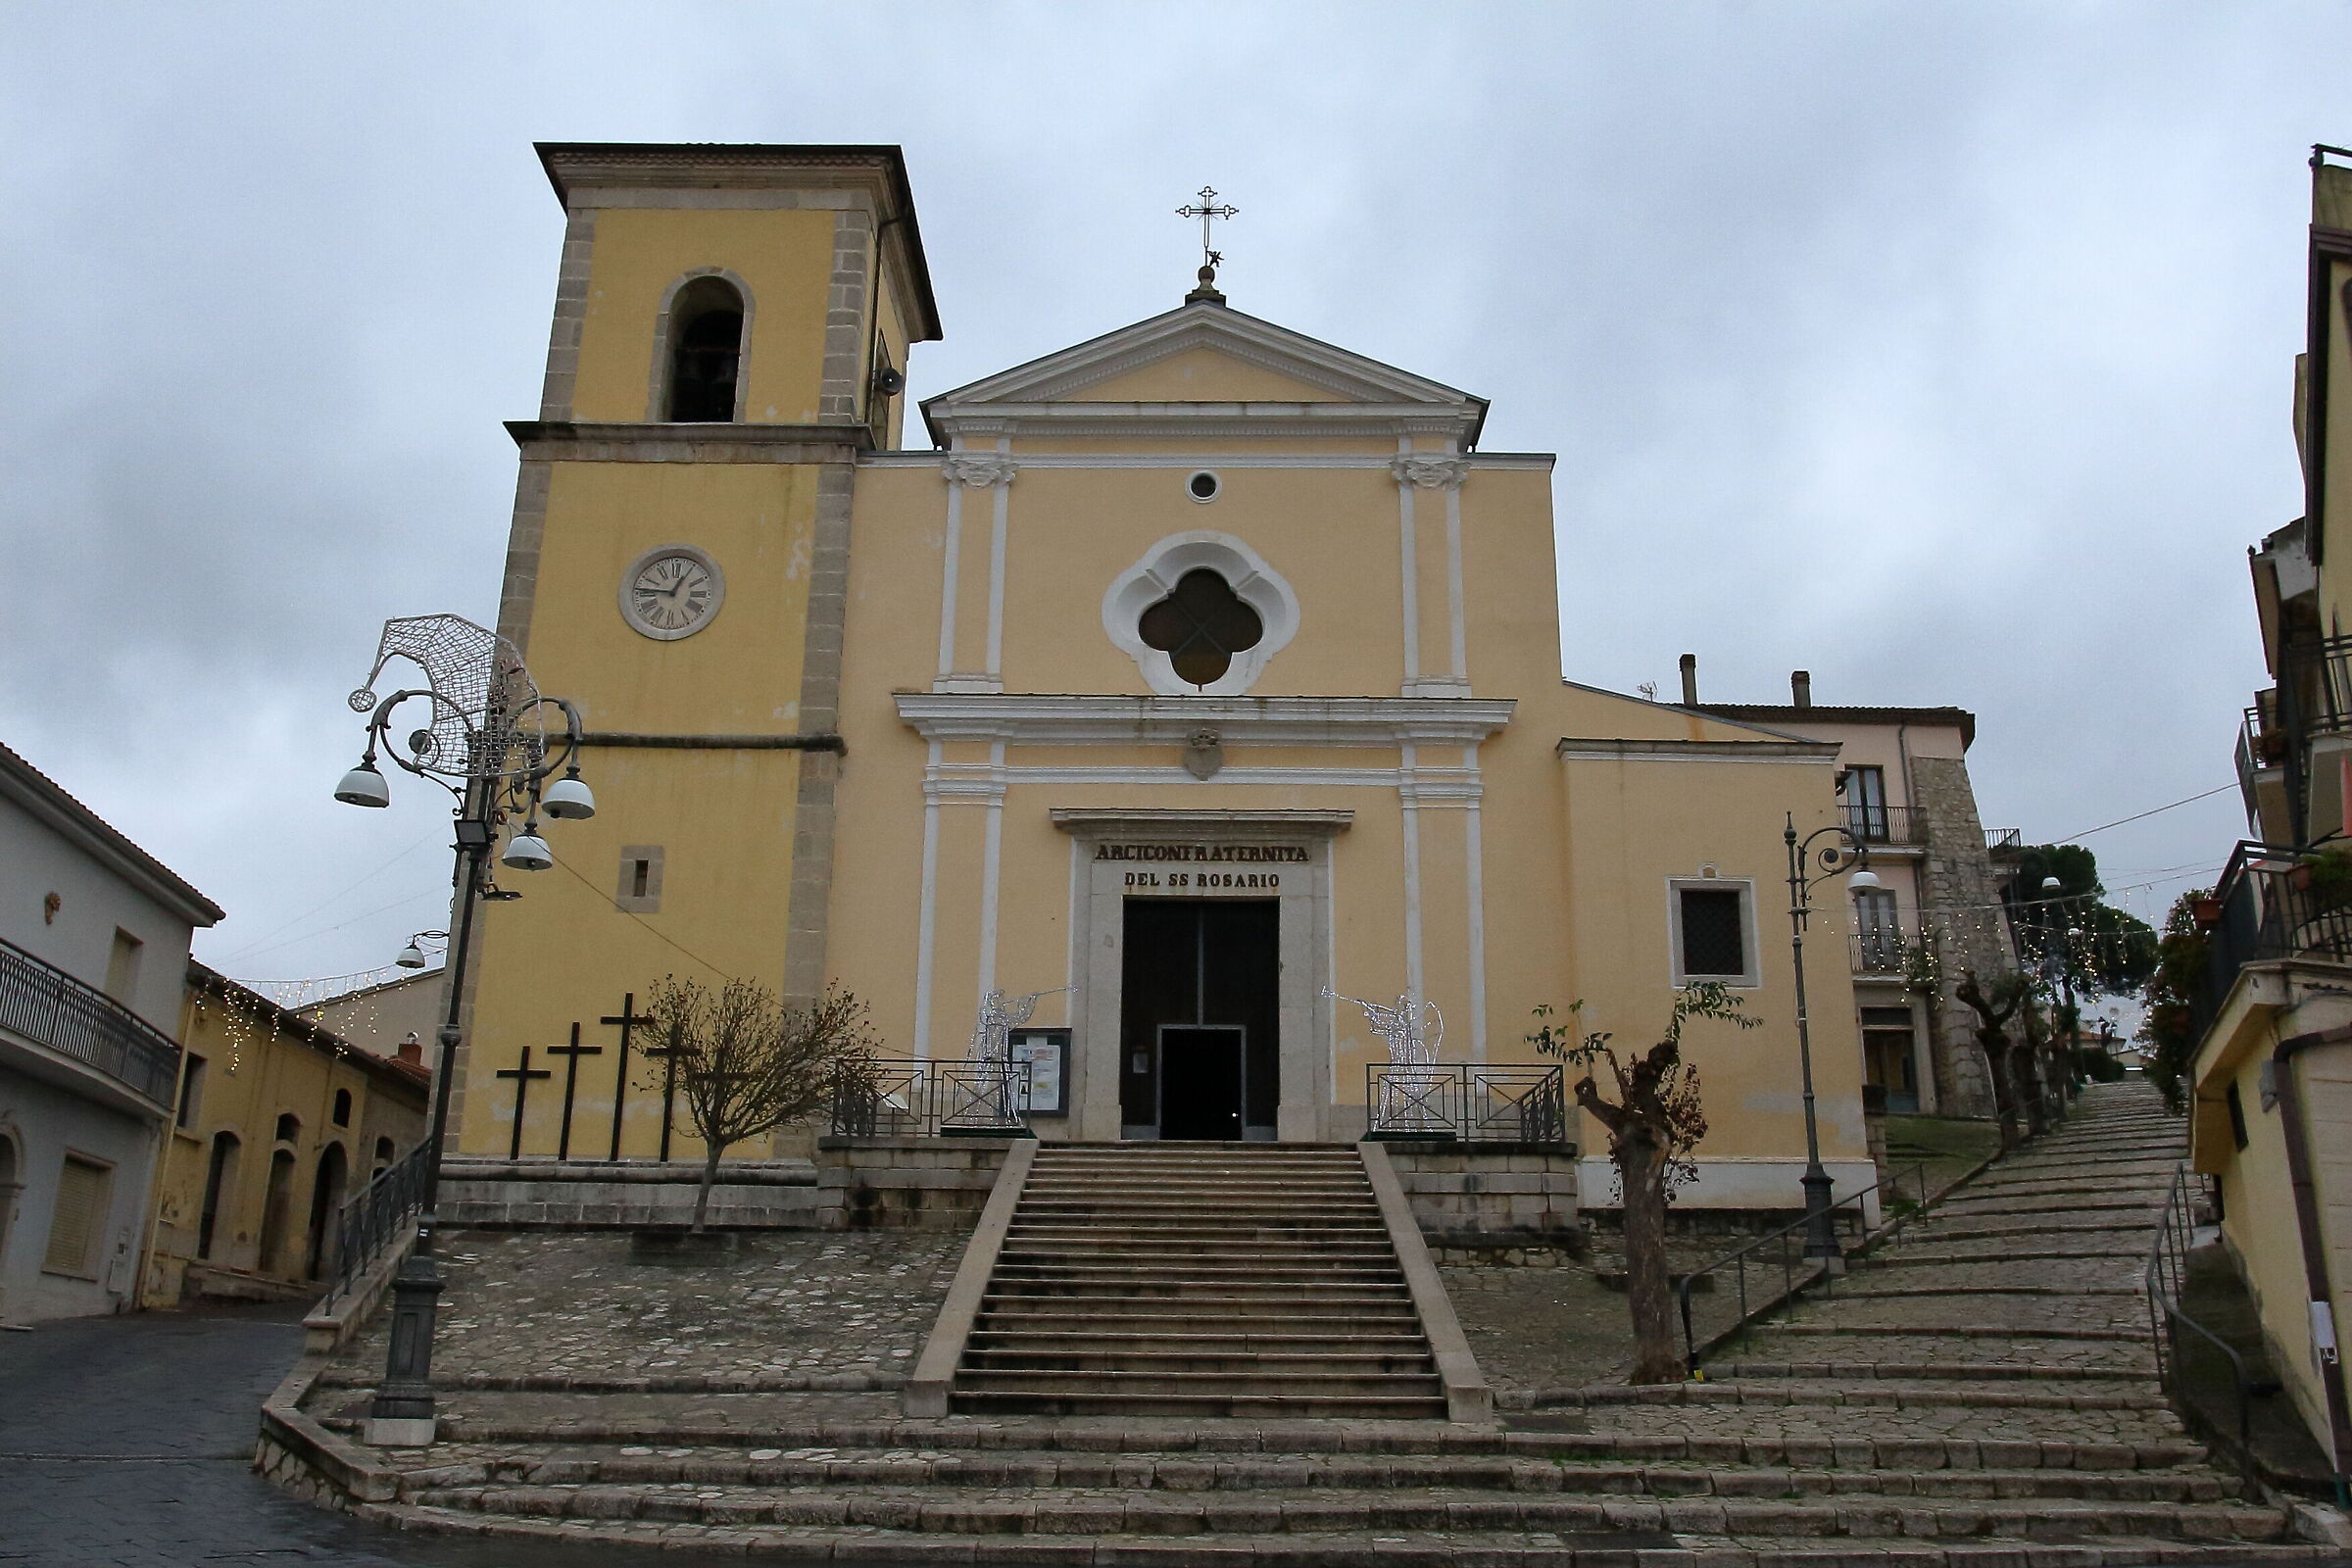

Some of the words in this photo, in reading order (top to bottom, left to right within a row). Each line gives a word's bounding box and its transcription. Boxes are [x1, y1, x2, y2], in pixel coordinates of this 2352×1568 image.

[1096, 845, 1309, 861] ARCICONFRATERNITA
[1124, 871, 1160, 886] DEL
[1168, 872, 1189, 887] SS
[1197, 873, 1280, 888] ROSARIO
